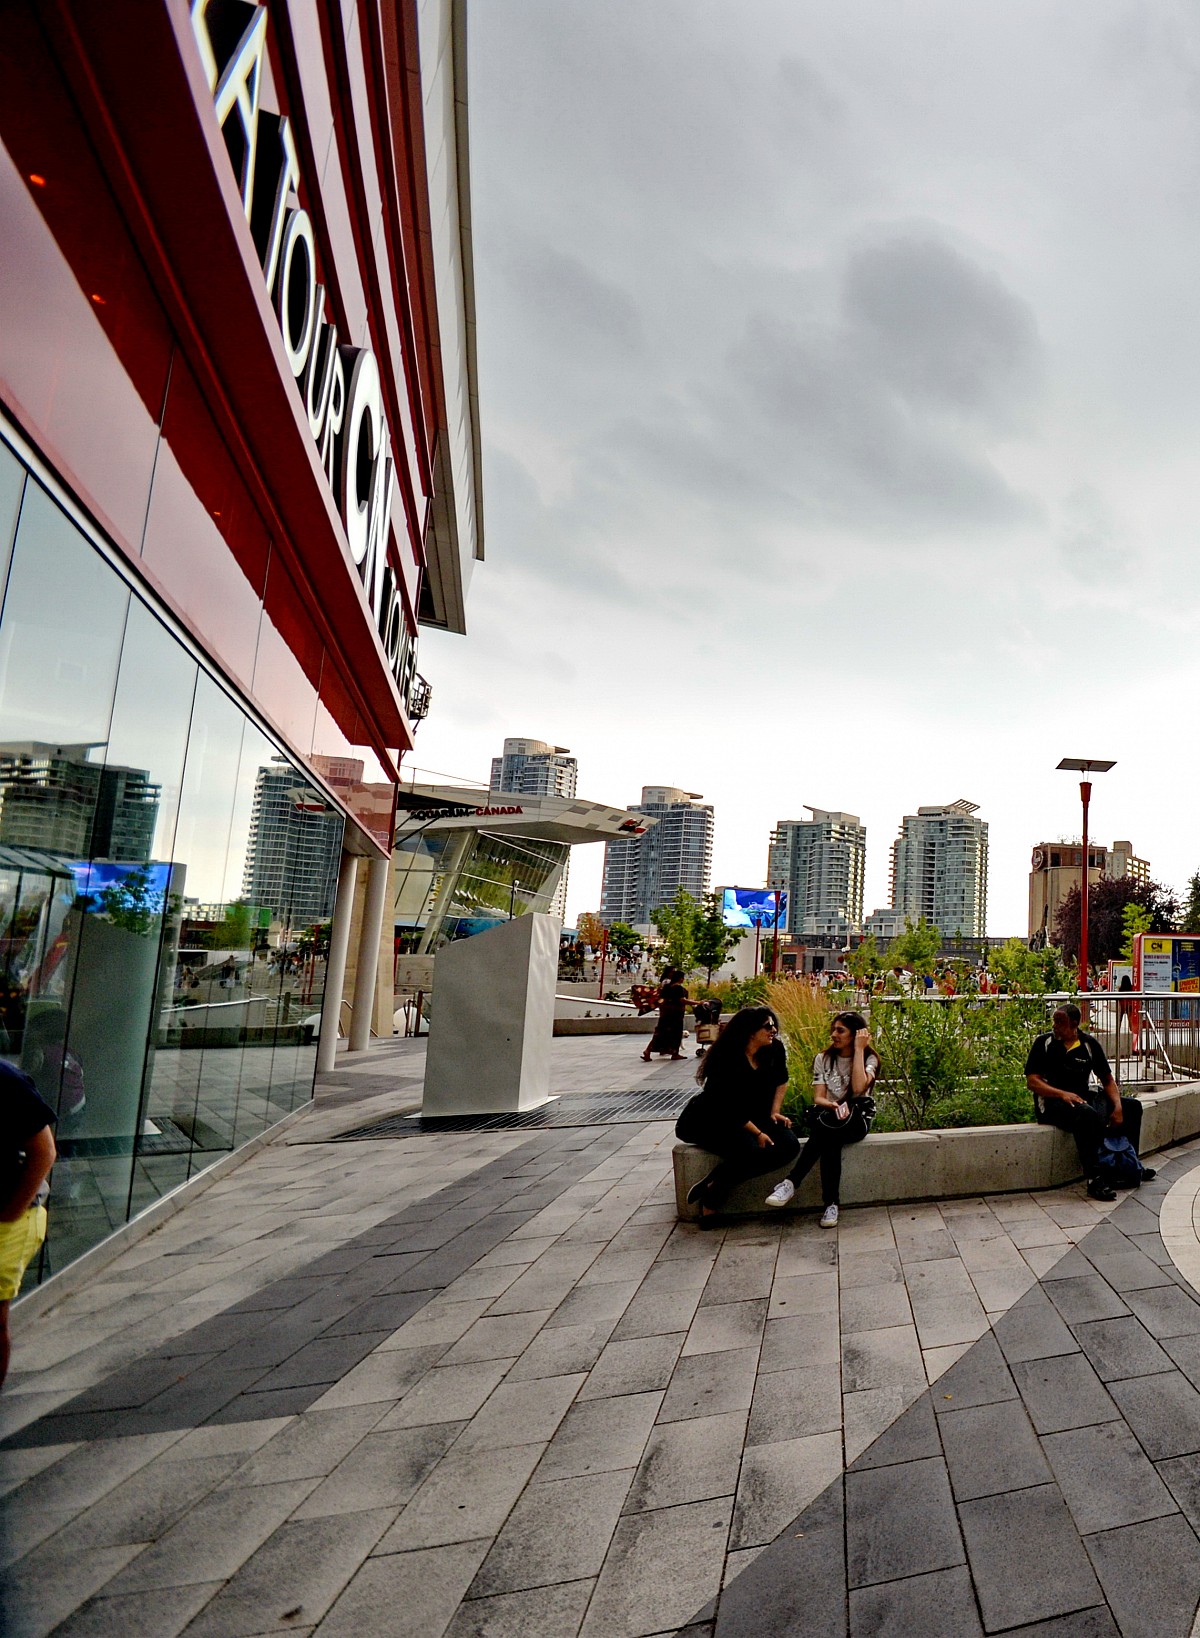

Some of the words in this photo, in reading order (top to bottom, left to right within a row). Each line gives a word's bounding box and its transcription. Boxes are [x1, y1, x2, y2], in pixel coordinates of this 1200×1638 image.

[343, 348, 395, 632] CN
[409, 808, 469, 821] AQUARIUM
[475, 806, 523, 816] CANADA
[1151, 942, 1163, 950] CN
